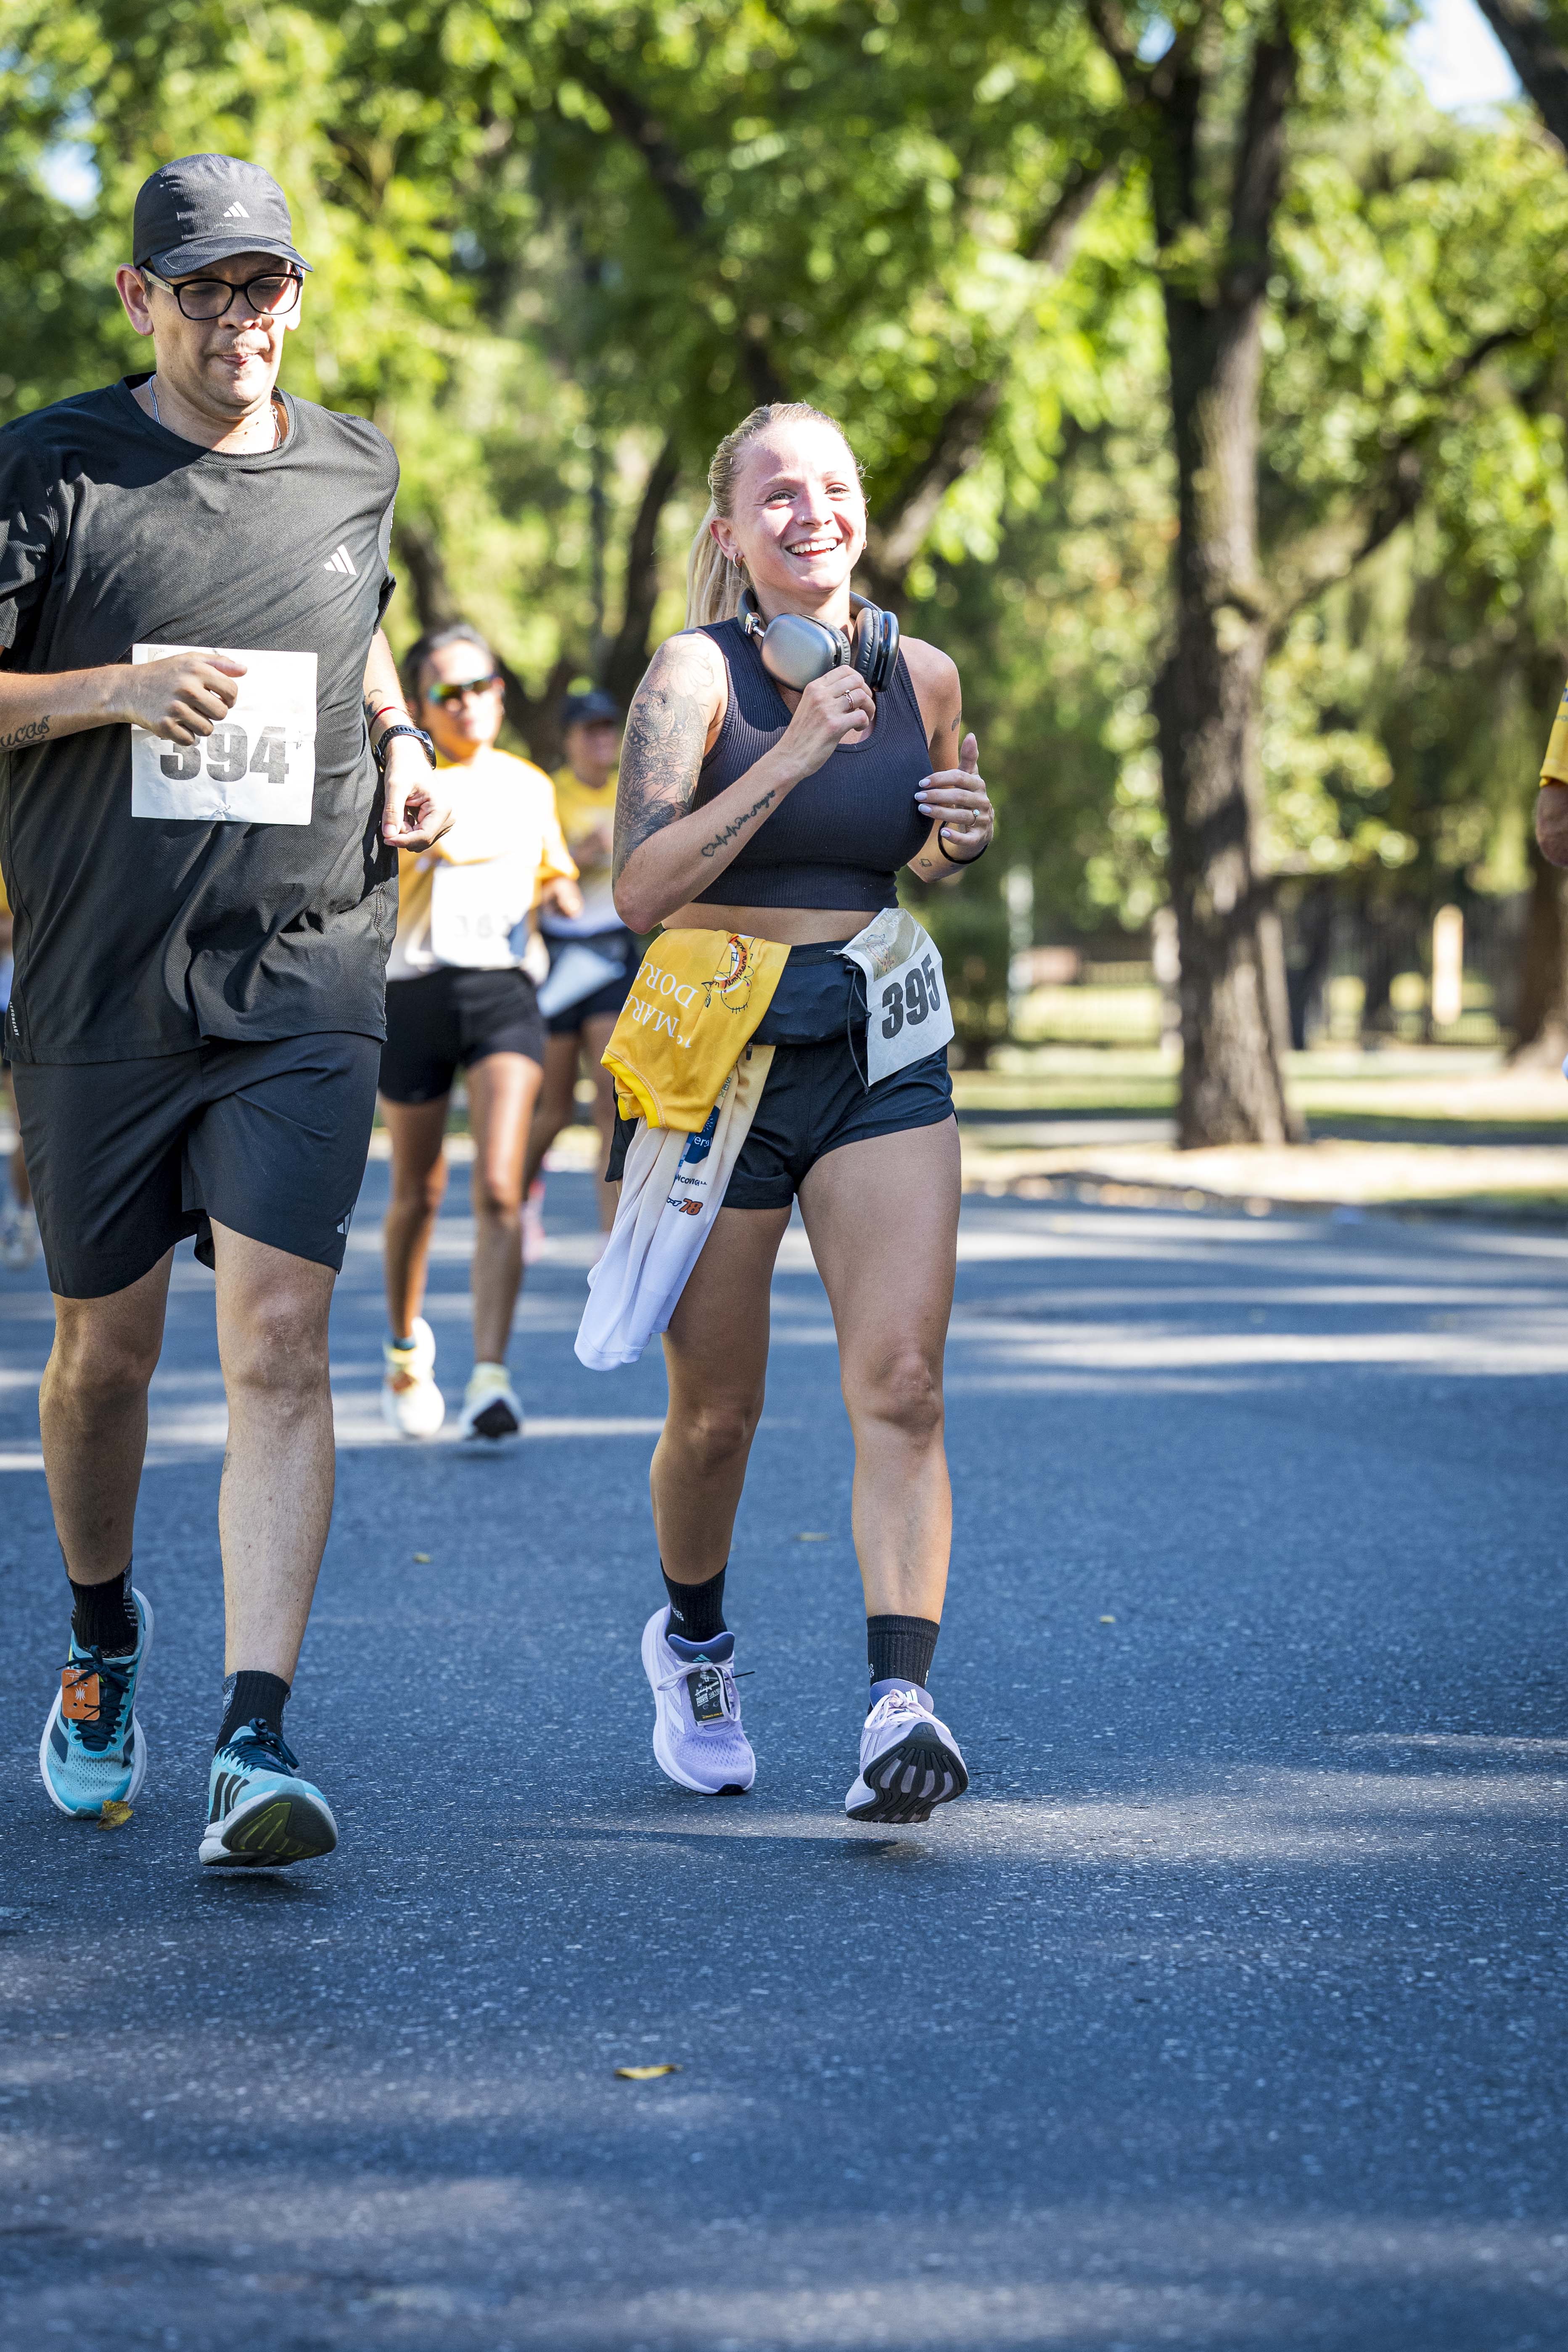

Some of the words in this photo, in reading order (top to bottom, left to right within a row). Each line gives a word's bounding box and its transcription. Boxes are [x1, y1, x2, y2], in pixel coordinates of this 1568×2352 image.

[160, 723, 289, 784] 394
[9, 1001, 20, 1036] AEROREADY
[882, 953, 940, 1039] 395
